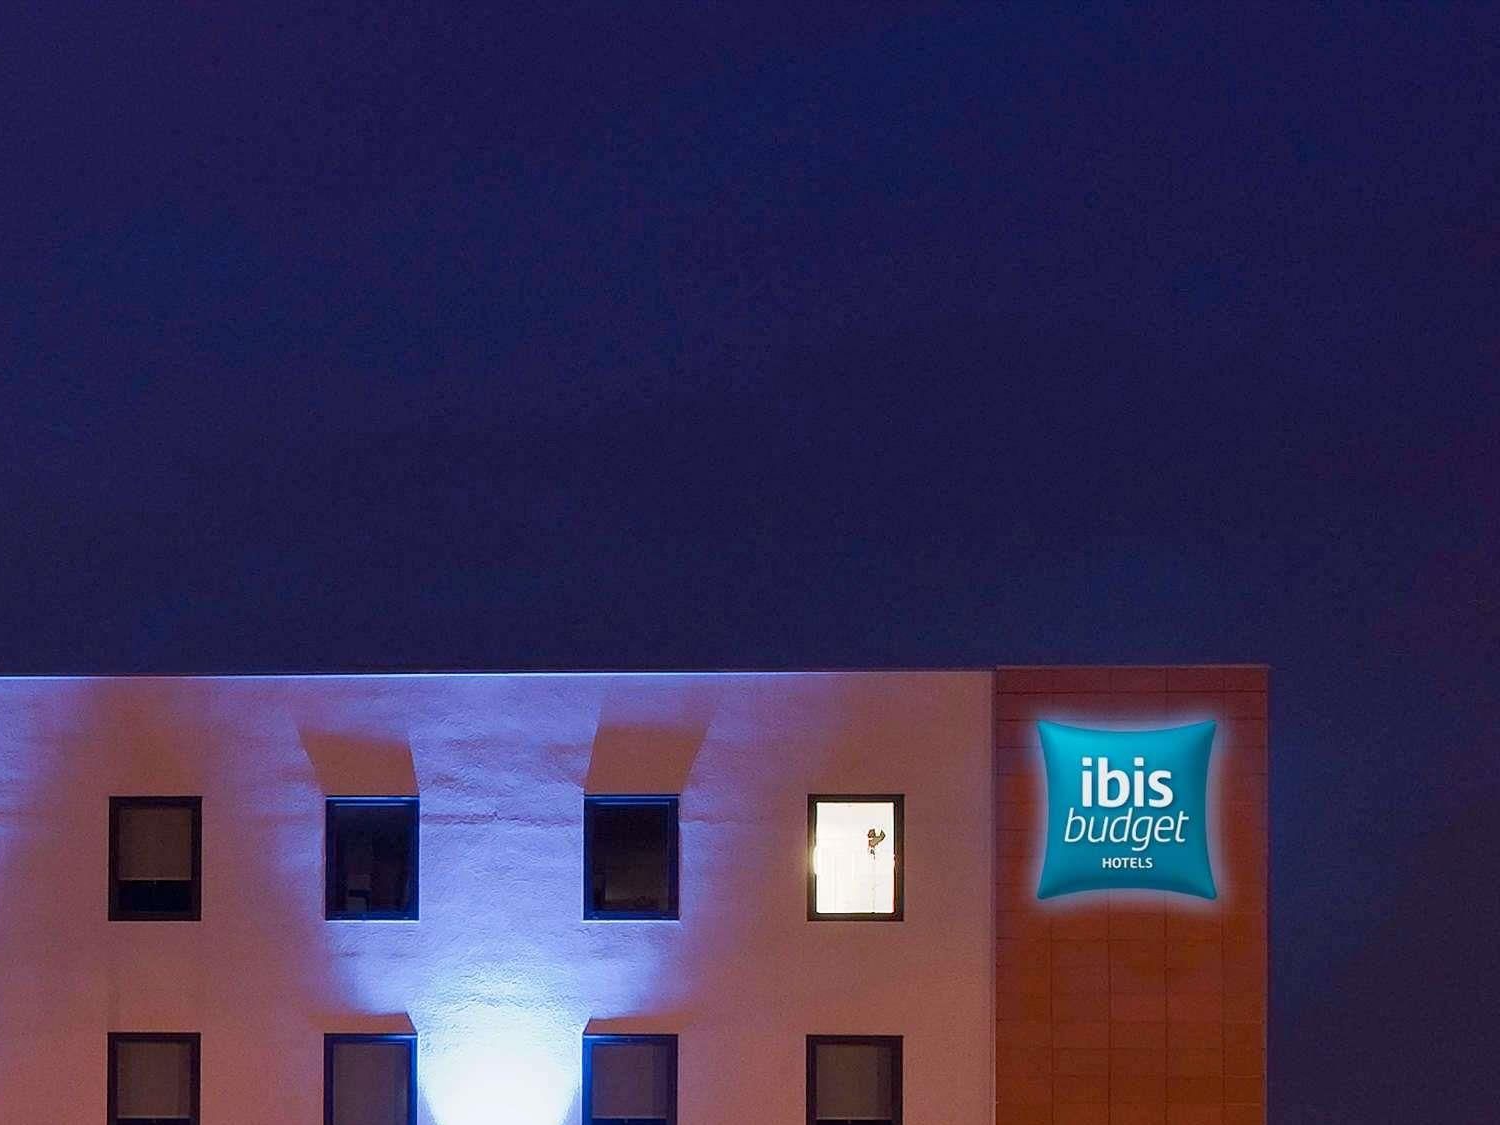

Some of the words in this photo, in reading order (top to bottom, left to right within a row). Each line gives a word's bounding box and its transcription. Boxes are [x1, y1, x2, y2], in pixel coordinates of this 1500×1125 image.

[1081, 756, 1174, 808] ibis
[1064, 807, 1189, 852] budget
[1102, 857, 1153, 869] HOTELS
